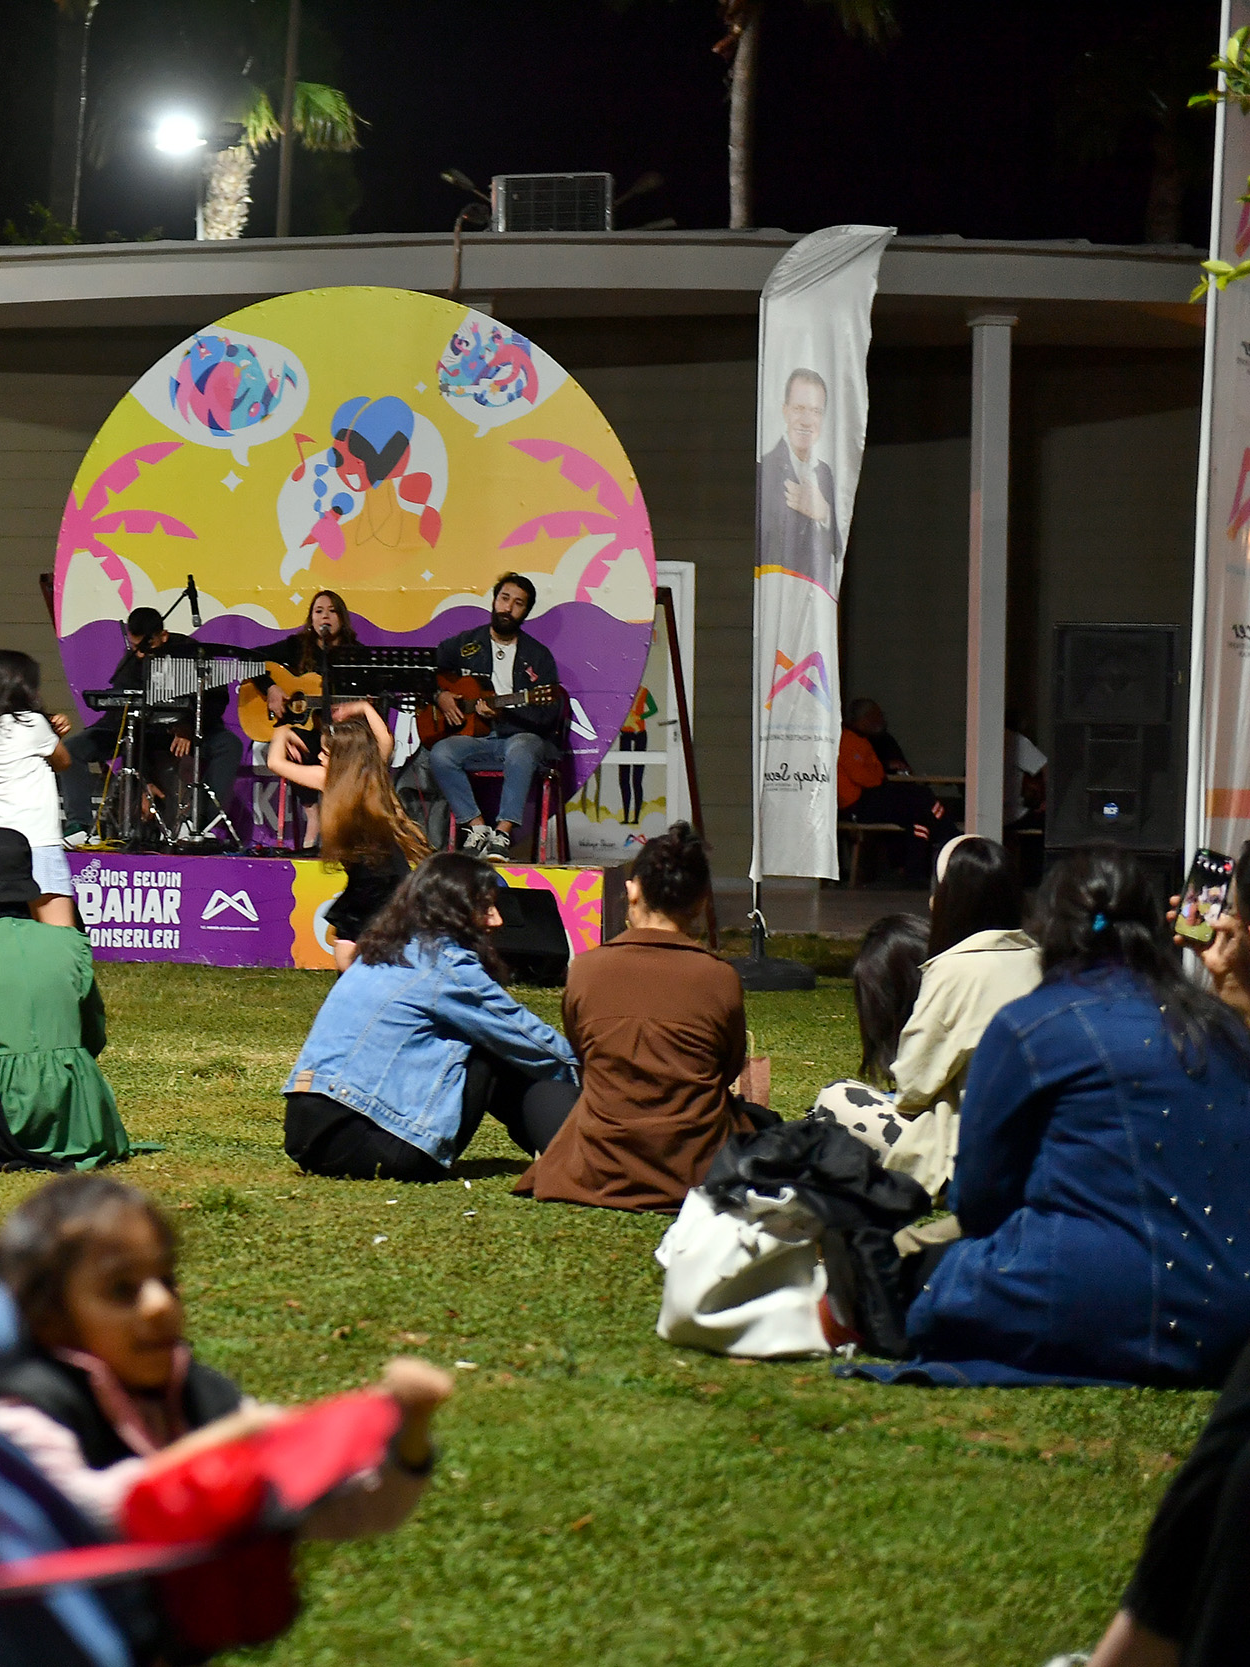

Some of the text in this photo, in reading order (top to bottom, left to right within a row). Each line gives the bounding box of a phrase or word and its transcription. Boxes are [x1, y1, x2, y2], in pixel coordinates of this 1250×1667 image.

[99, 869, 182, 888] HOŞ GELDİN
[76, 883, 181, 924] BAHAR
[85, 926, 180, 949] ONSERLERİ
